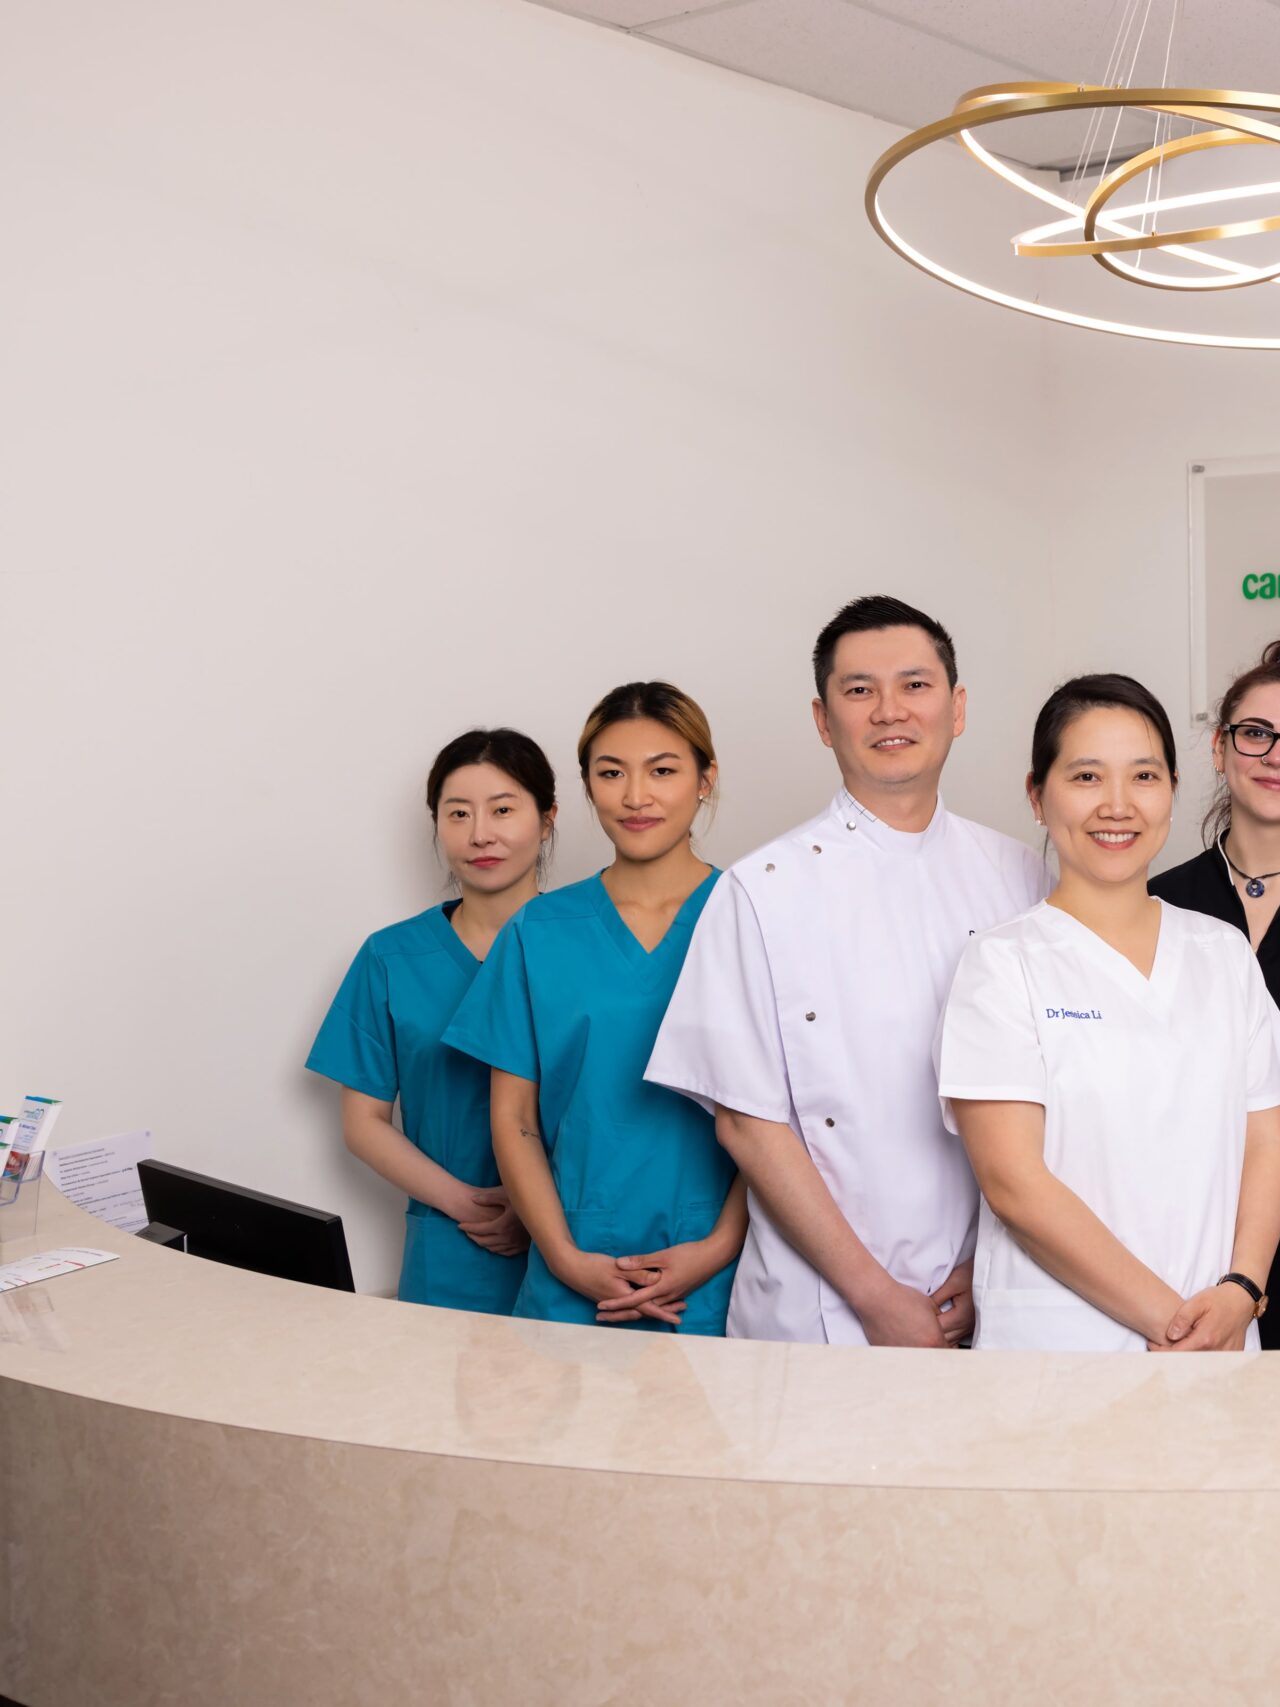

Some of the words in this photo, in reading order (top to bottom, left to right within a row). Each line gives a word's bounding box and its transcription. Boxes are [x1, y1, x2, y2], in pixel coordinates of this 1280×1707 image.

[1046, 1008, 1059, 1018] Dr
[1061, 1008, 1090, 1019] Jessica
[1091, 1009, 1102, 1019] Li
